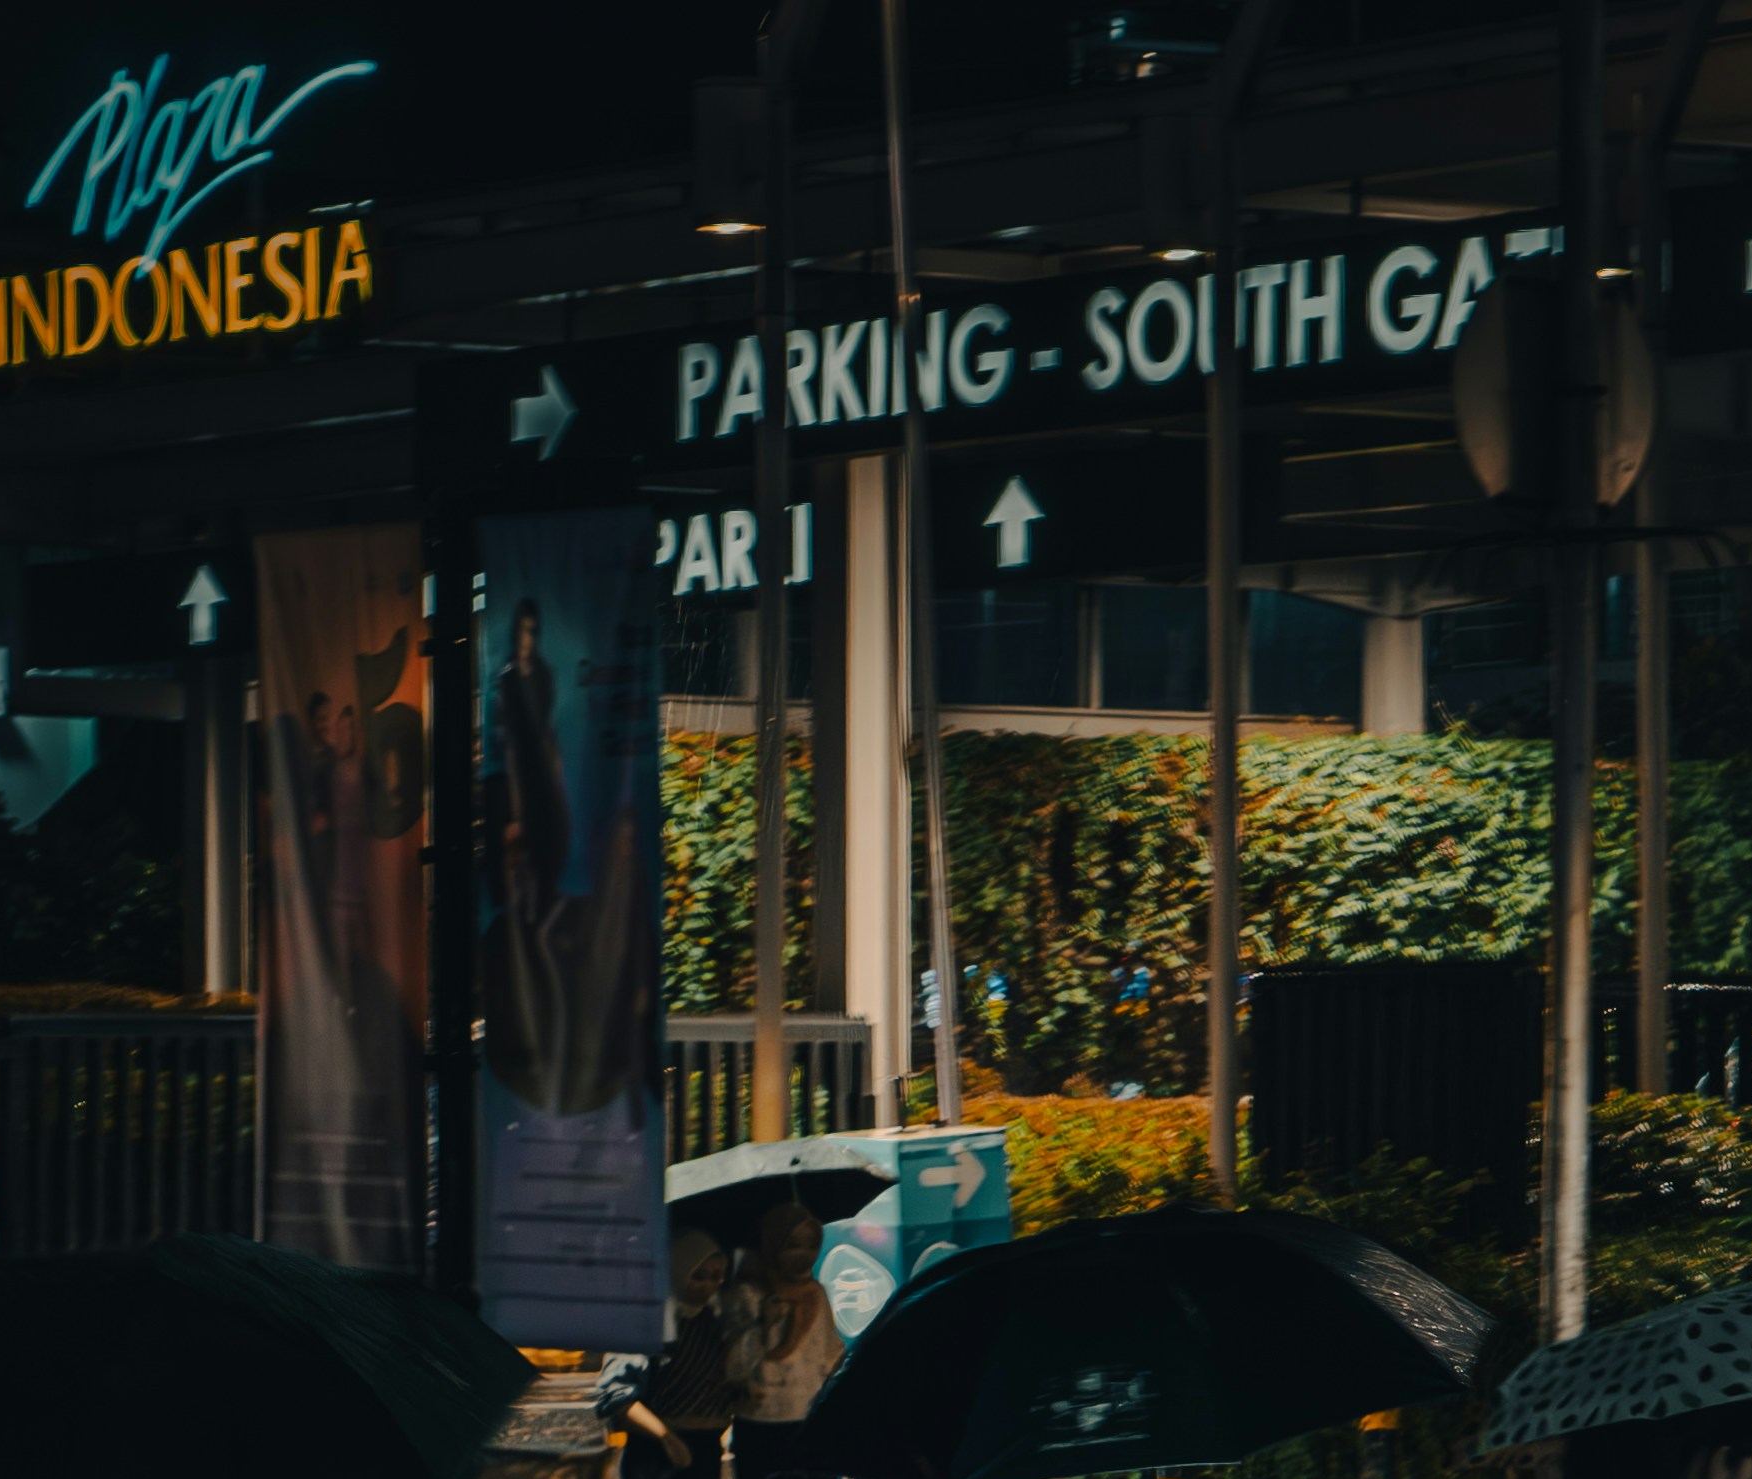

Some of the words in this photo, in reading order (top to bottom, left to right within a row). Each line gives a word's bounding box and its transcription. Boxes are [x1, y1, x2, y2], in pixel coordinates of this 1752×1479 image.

[24, 52, 378, 280] Plaza
[676, 302, 1016, 444] PARKING
[1080, 255, 1346, 391] SOUTH
[1365, 225, 1565, 355] GA
